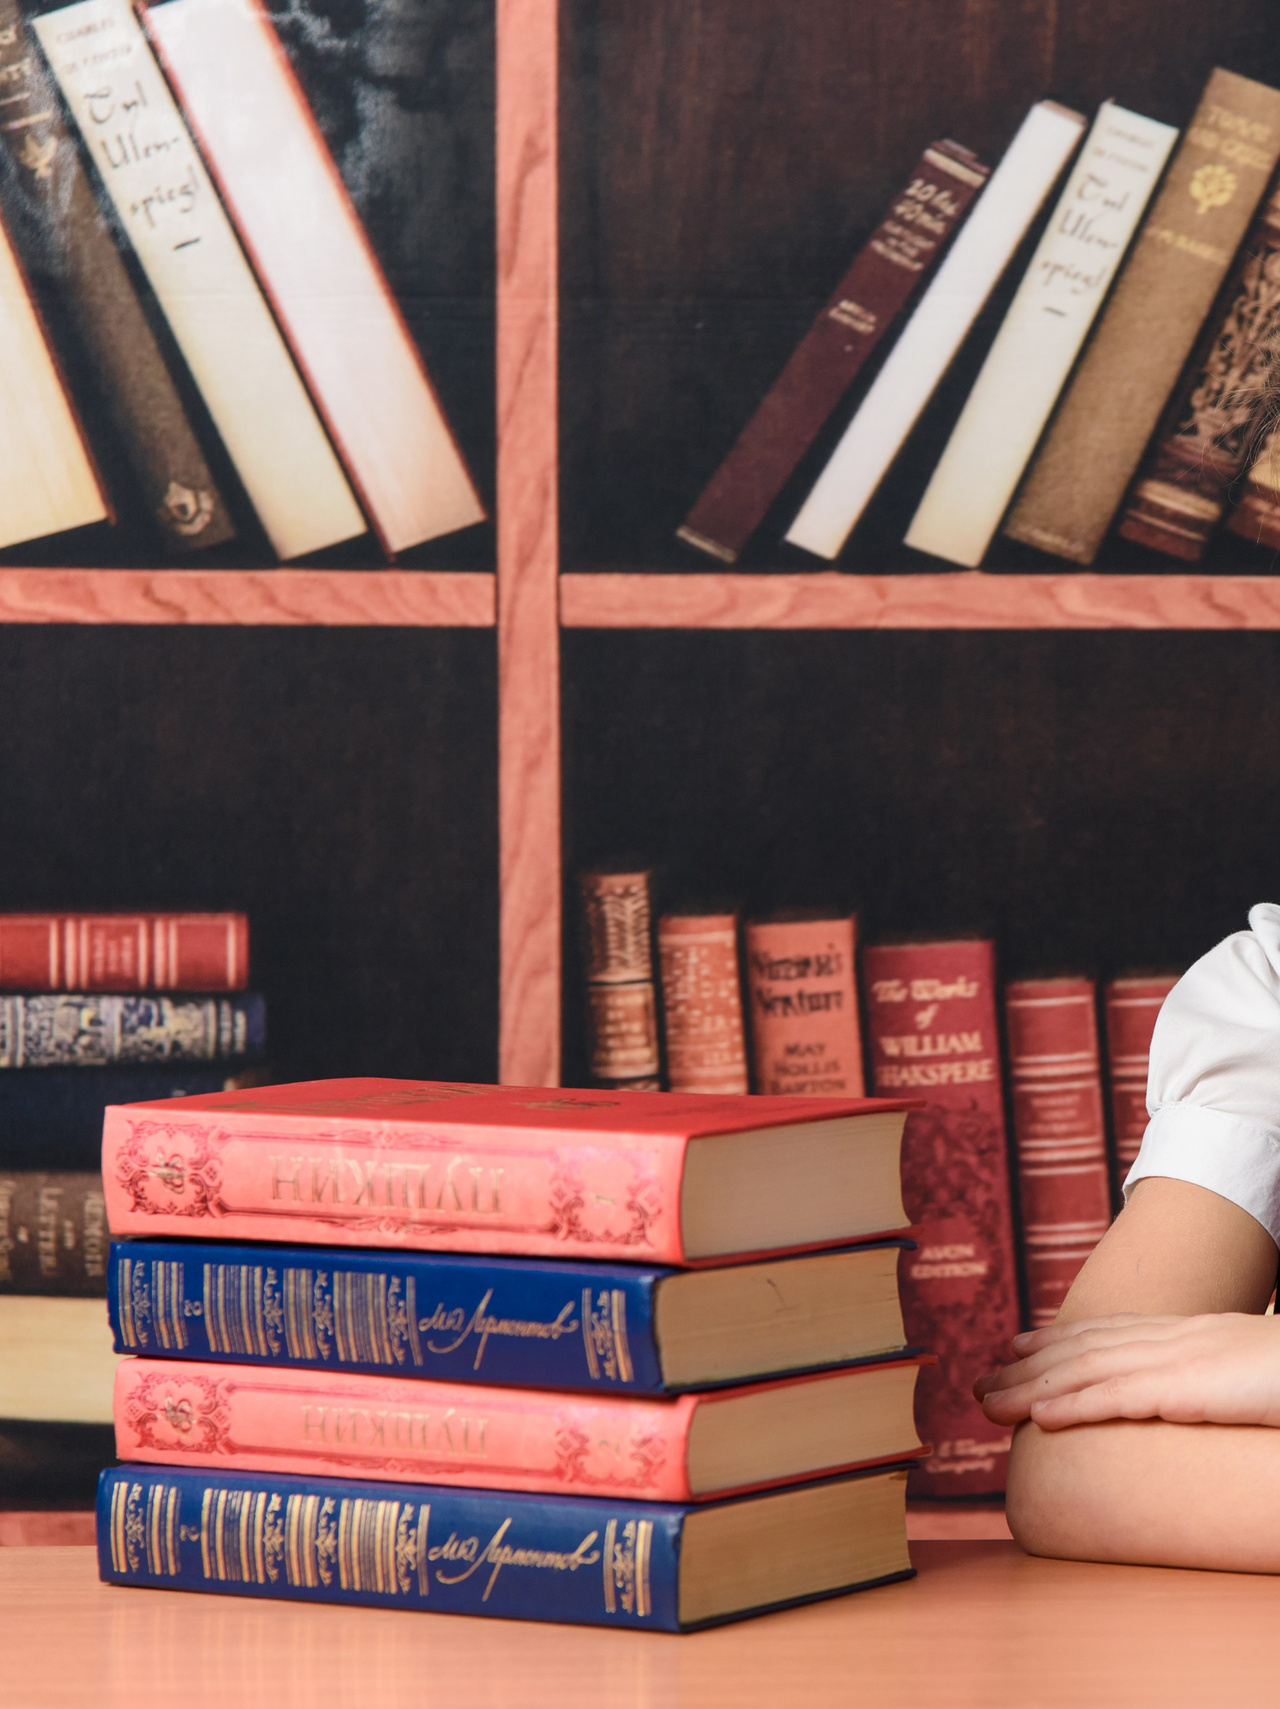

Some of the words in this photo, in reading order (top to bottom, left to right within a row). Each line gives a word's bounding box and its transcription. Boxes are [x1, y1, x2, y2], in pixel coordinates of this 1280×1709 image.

[914, 1003, 938, 1030] of
[879, 1031, 984, 1058] WILLIAM
[269, 1154, 504, 1214] ПУШКИН
[300, 1404, 488, 1458] ПУШКИН
